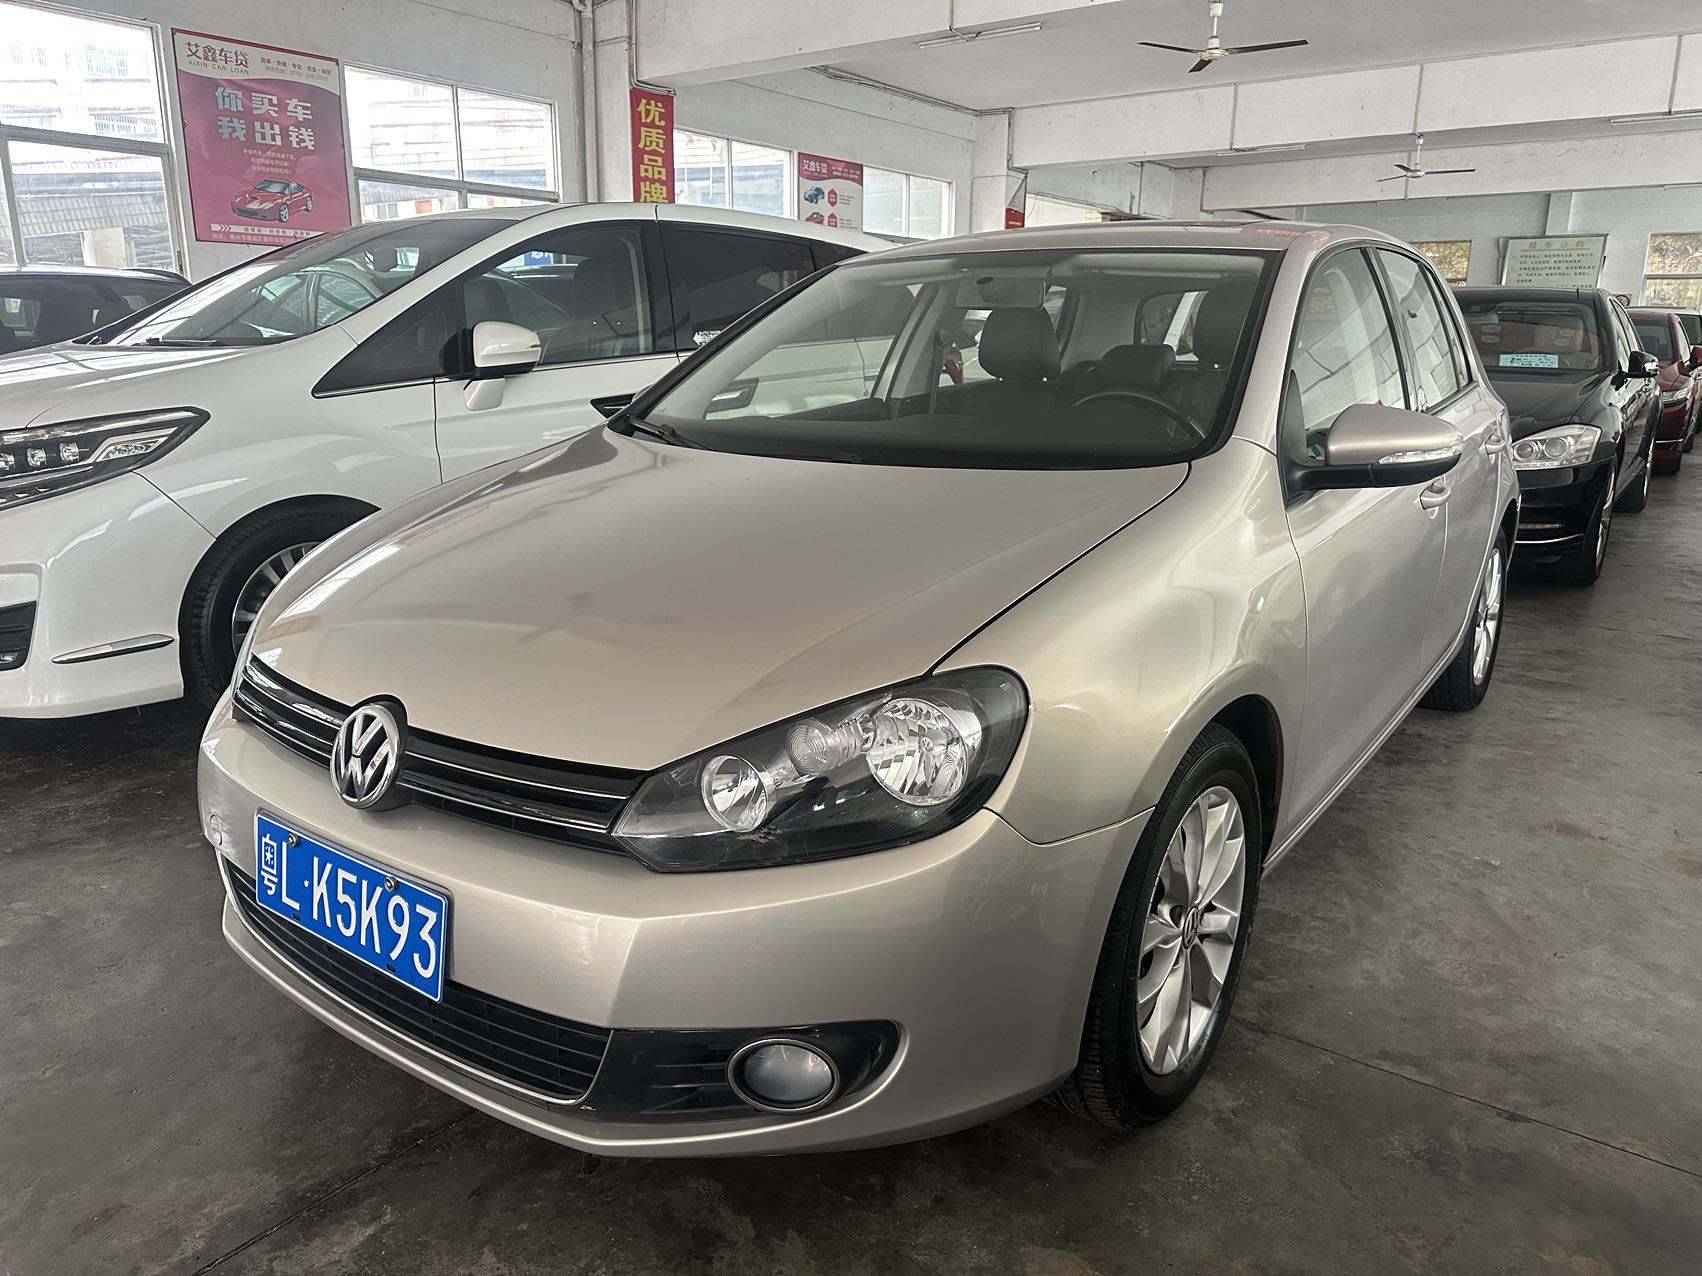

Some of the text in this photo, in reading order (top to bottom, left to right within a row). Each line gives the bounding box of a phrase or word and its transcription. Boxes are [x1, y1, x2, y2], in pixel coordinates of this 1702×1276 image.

[185, 42, 249, 68] 艾鑫车贷
[189, 60, 208, 68] AIXIN
[231, 67, 249, 75] LOAN
[215, 87, 312, 121] 你买车
[218, 116, 315, 150] 我出钱
[637, 98, 669, 203] 优质品牌
